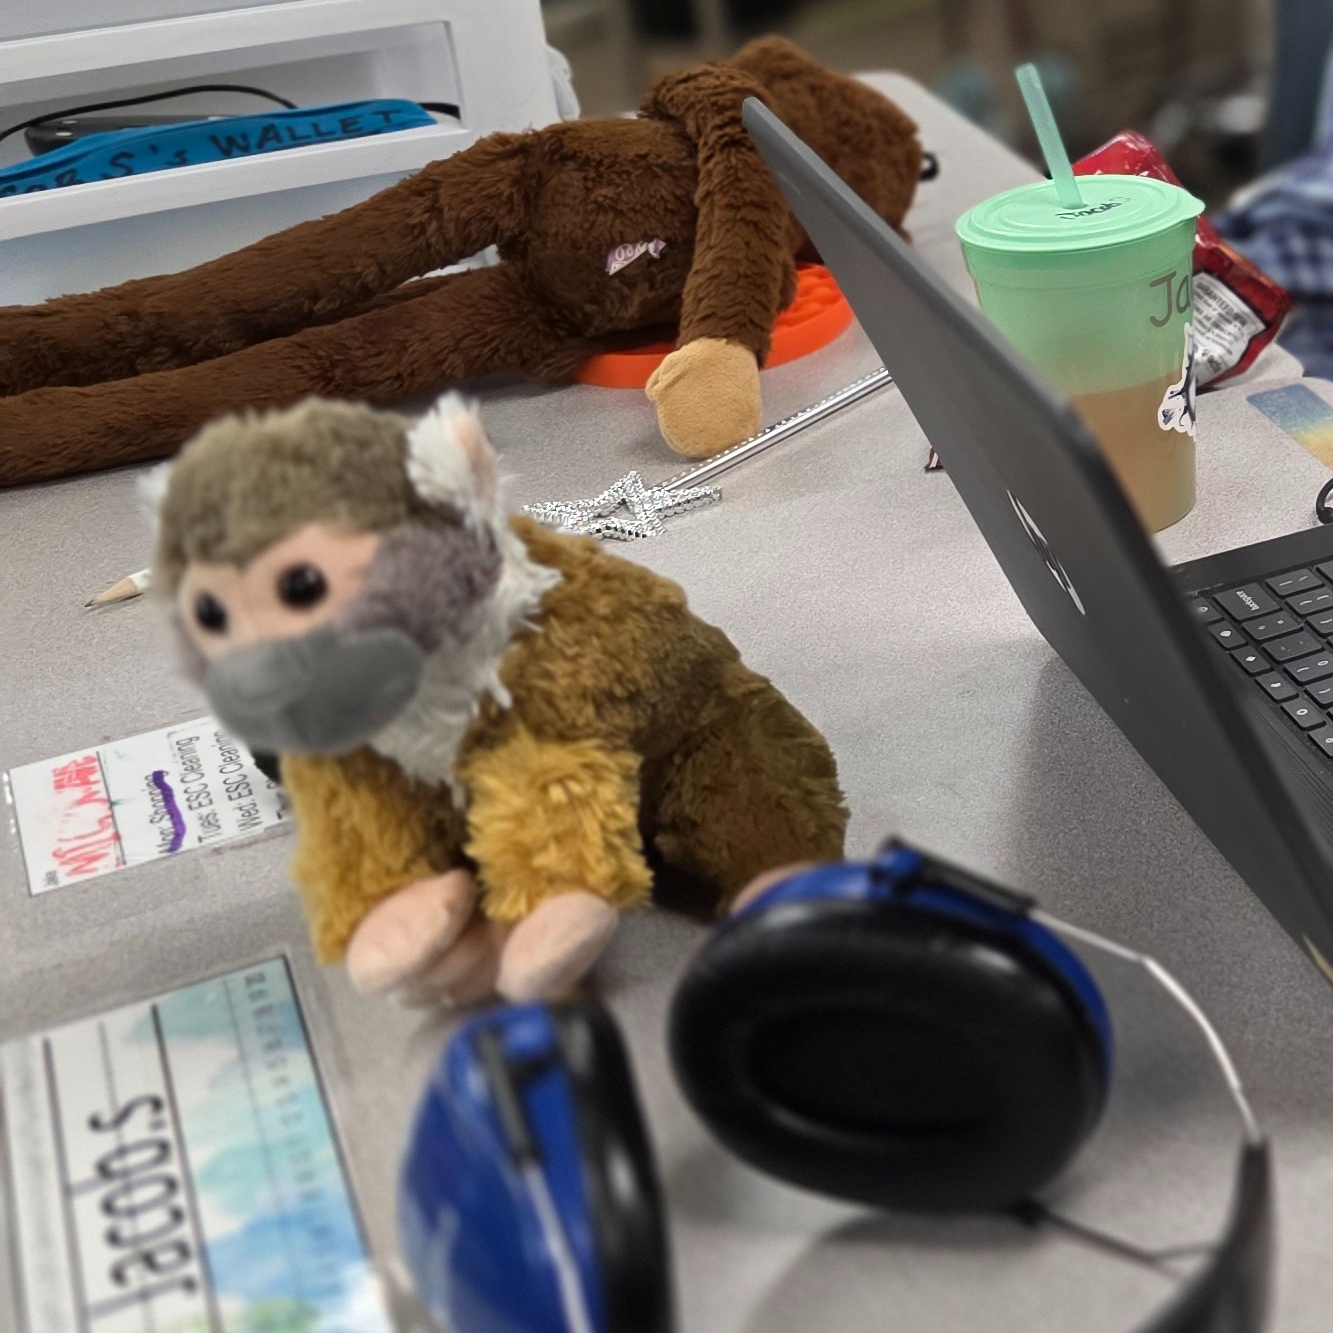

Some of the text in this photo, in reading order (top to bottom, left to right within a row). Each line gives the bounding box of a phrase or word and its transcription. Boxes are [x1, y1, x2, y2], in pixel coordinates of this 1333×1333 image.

[208, 109, 404, 158] WALLET
[175, 735, 223, 844] Tues: ESC Cleaning
[221, 774, 254, 802] ESC
[236, 798, 263, 833] Wed:
